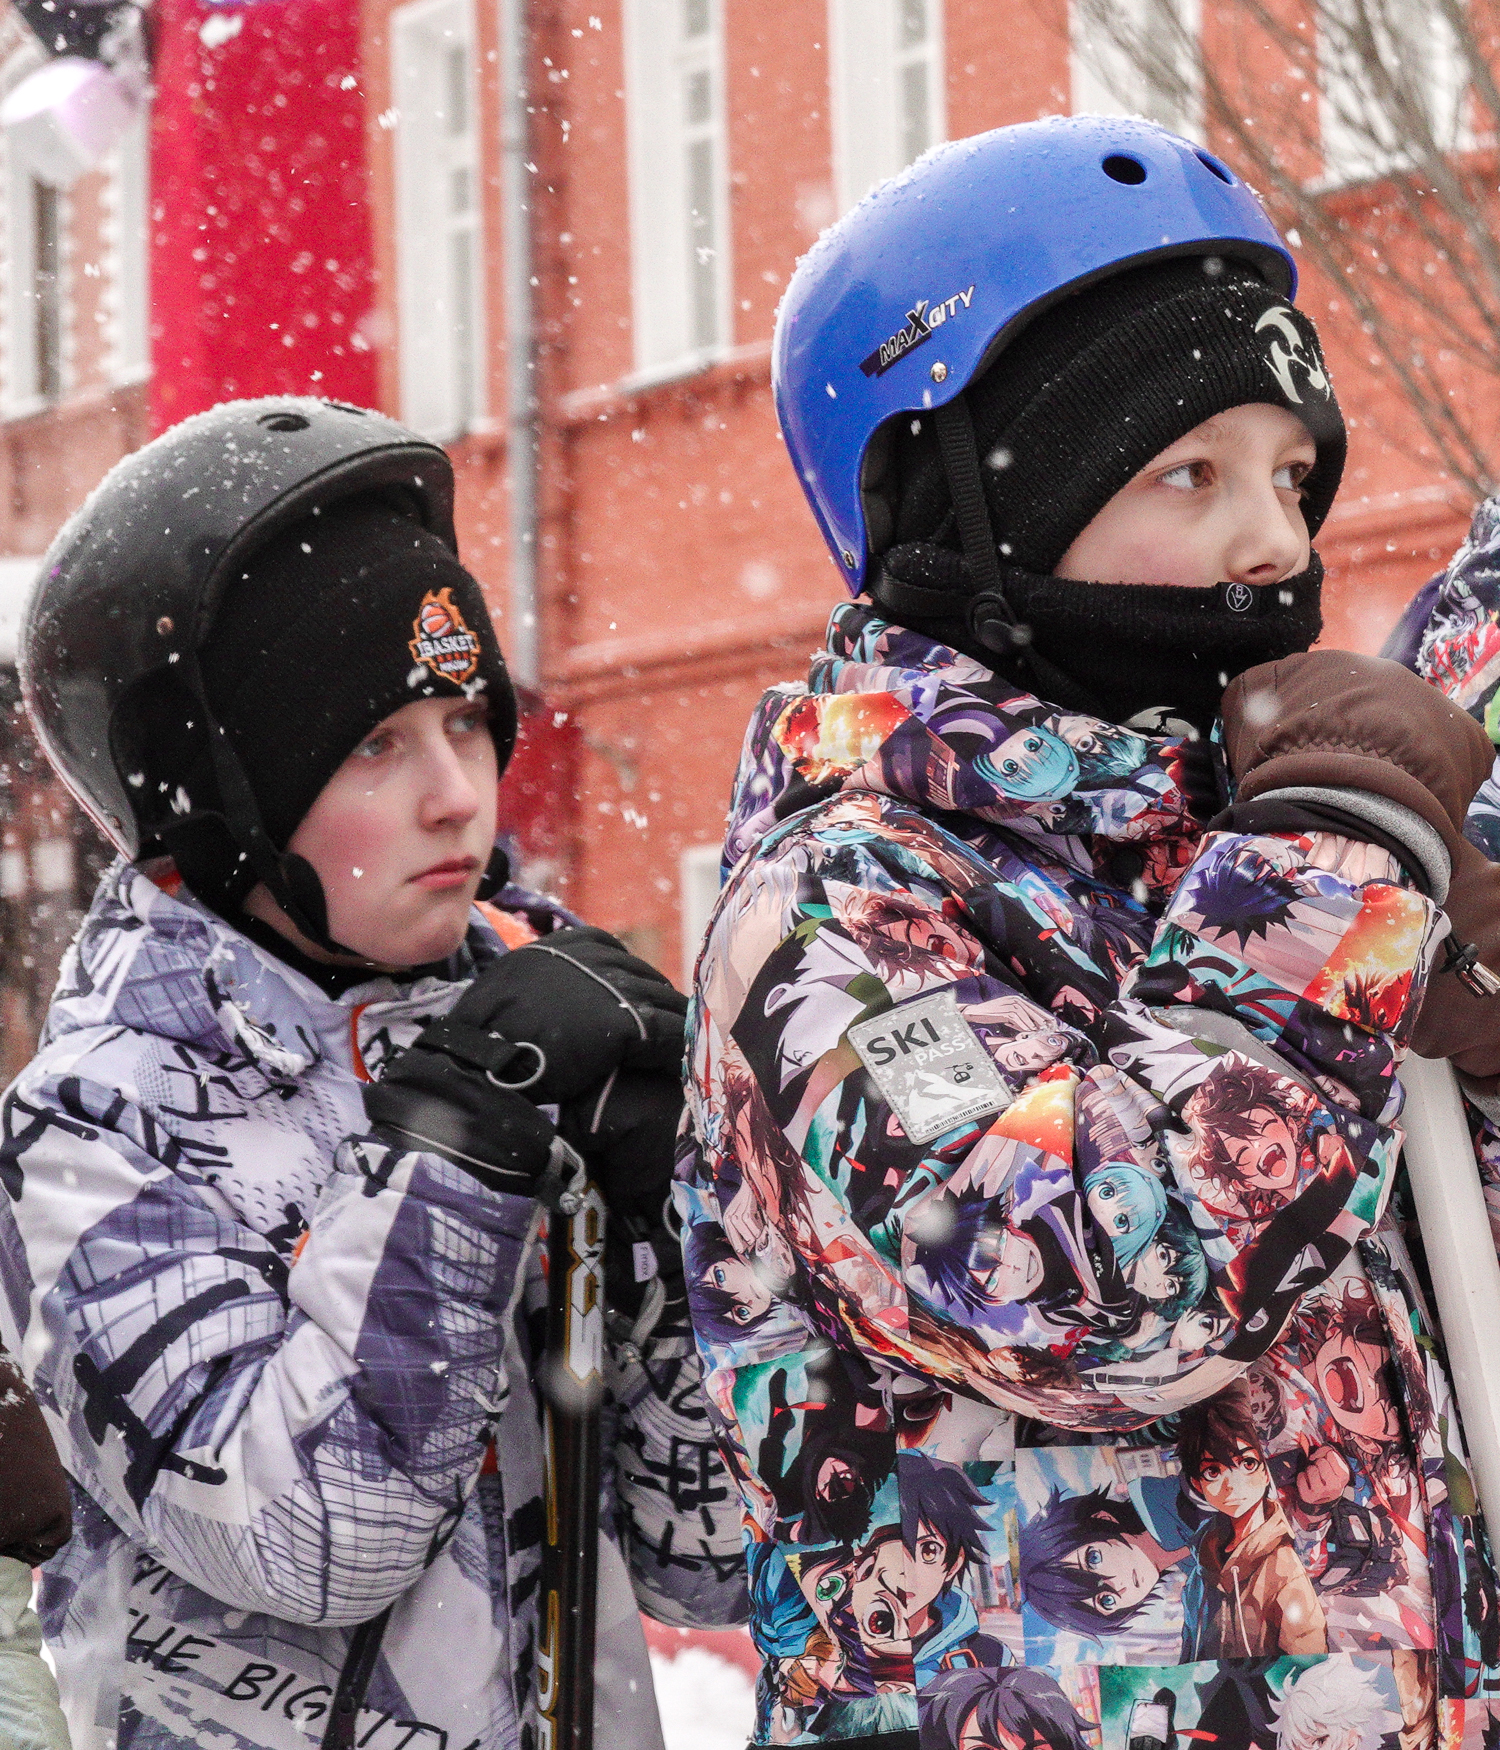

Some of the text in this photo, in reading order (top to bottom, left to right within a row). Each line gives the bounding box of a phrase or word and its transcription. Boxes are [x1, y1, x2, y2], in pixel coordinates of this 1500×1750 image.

[866, 1017, 941, 1066] SKI
[914, 1038, 966, 1067] PASS
[127, 1608, 216, 1672] HE
[222, 1662, 333, 1723] BIG
